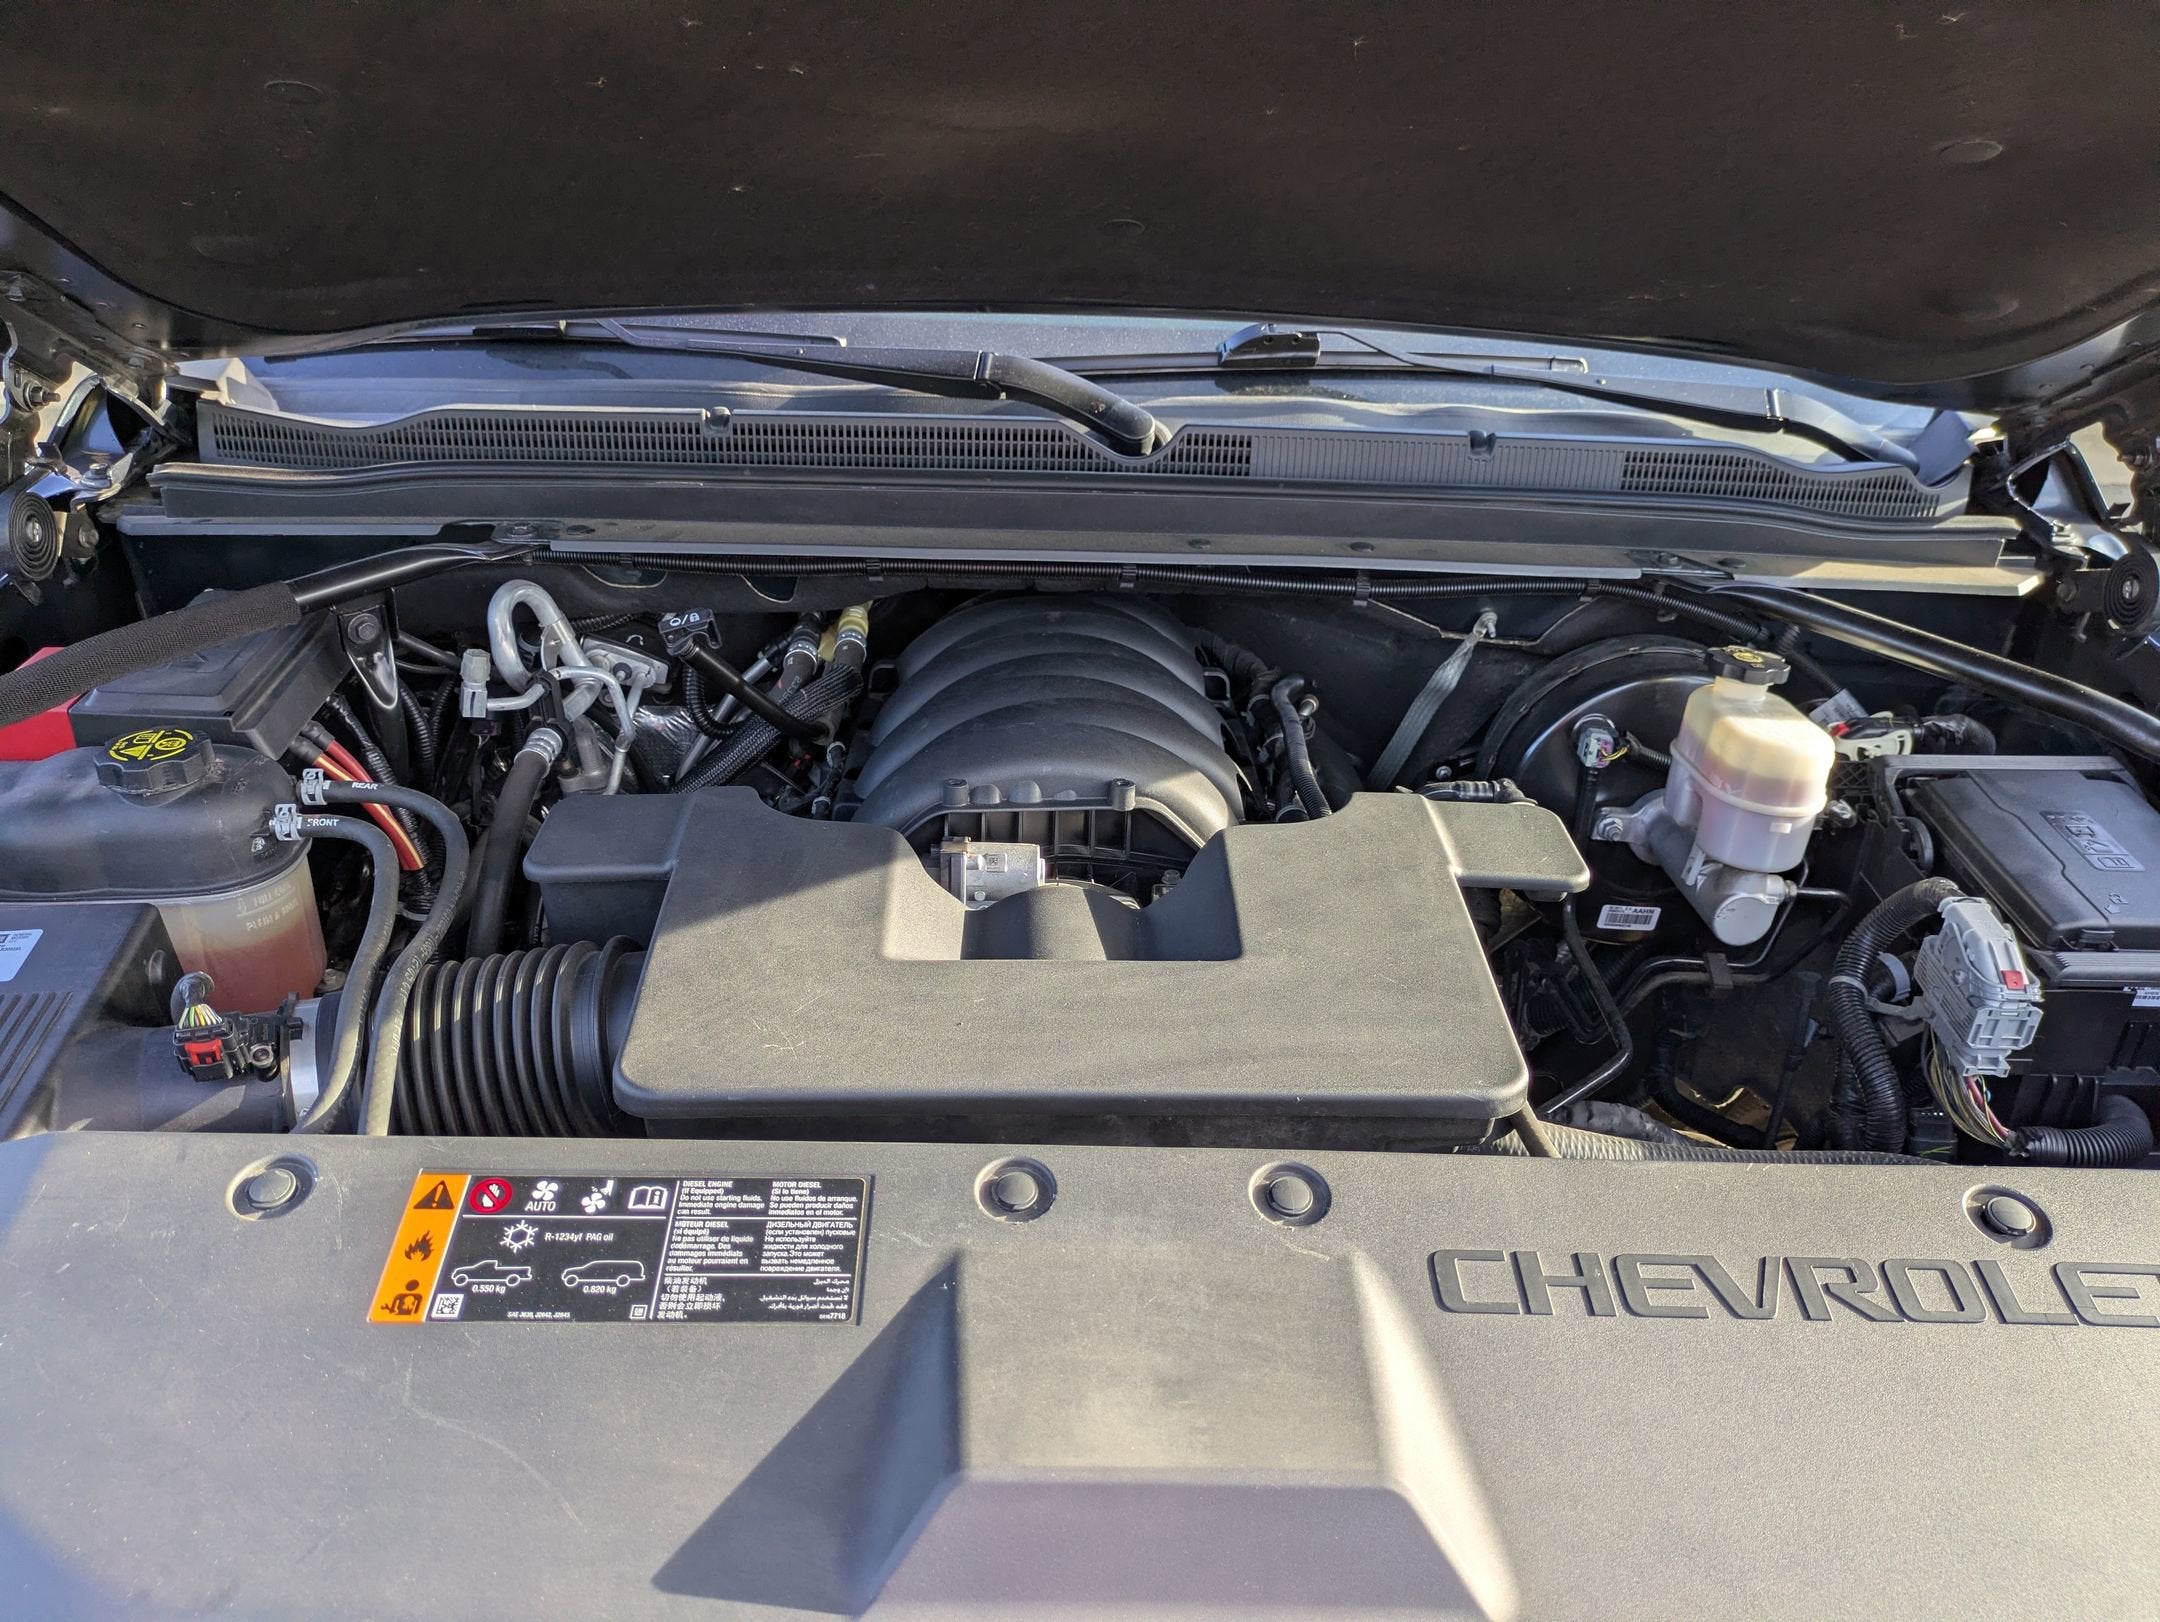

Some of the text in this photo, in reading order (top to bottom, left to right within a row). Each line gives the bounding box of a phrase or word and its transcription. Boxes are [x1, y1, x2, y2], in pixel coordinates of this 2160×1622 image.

[352, 782, 378, 790] REAR
[307, 819, 339, 827] FRONT
[525, 1201, 556, 1211] AUTO
[544, 1233, 613, 1242] R-1234yf PAG oil
[472, 1285, 506, 1294] 0.550 kg
[583, 1285, 616, 1294] 0.820 kg
